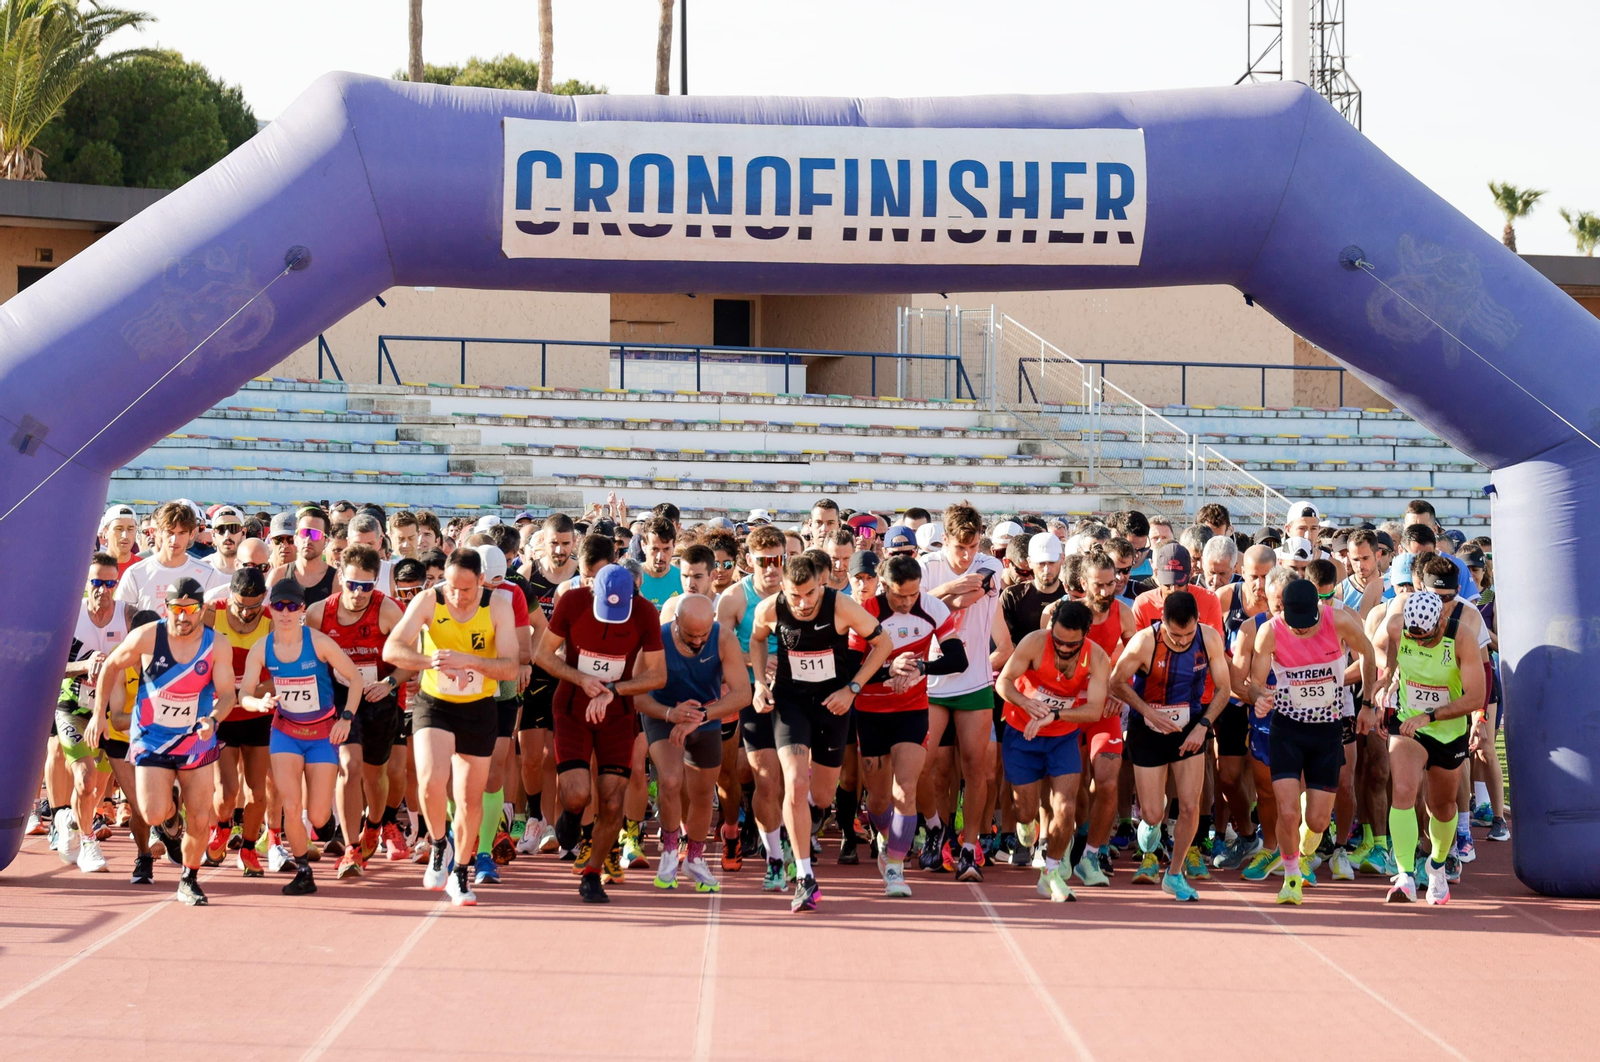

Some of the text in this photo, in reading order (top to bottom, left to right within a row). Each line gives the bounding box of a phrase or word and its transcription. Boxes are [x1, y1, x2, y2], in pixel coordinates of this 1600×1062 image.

[515, 149, 1136, 244] CRONOFINISHER
[593, 660, 609, 672] 54
[800, 658, 824, 670] 511
[1286, 667, 1333, 679] ENTRENA
[281, 690, 311, 701] 775
[1300, 686, 1325, 697] 353
[1415, 690, 1440, 702] 278
[161, 704, 191, 717] 774
